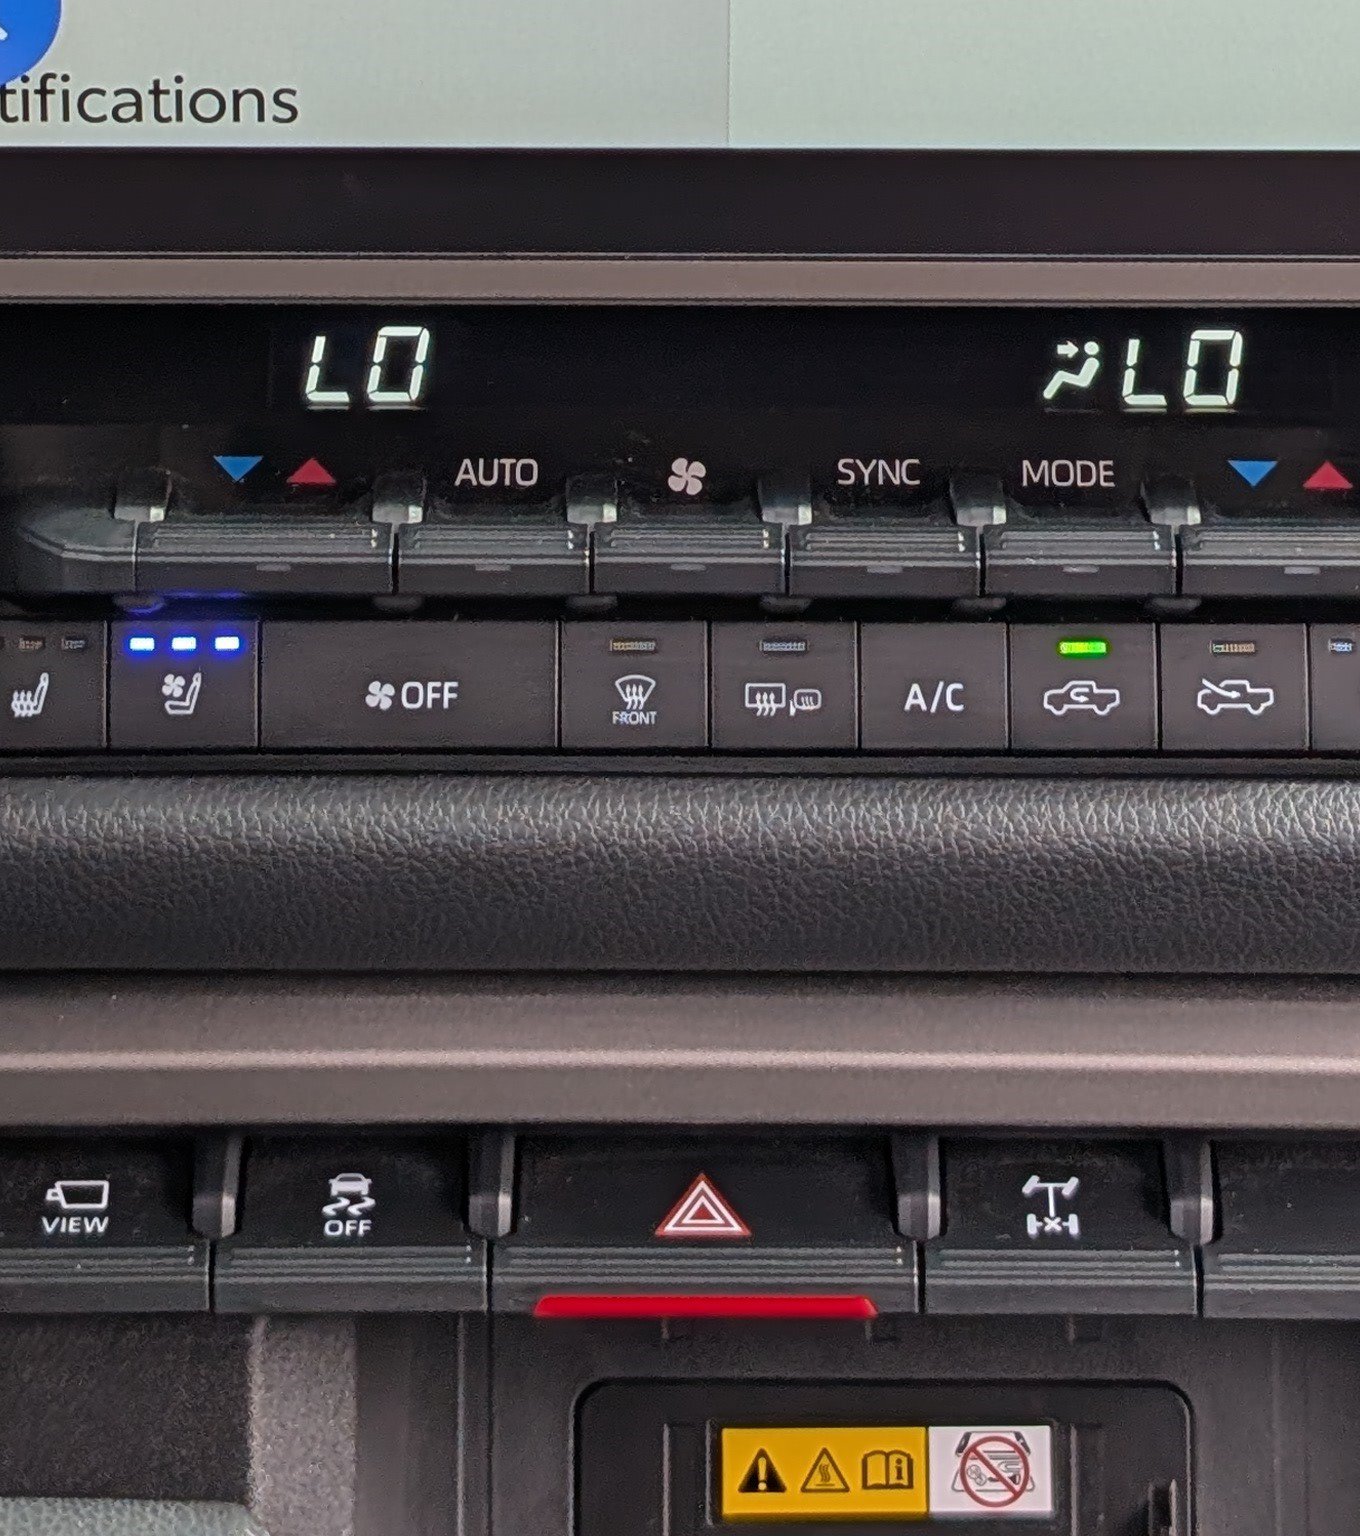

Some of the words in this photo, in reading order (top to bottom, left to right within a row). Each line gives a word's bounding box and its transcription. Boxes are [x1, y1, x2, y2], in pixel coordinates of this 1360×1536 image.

[455, 458, 538, 487] AUTO
[838, 459, 920, 485] SYNC
[1023, 460, 1115, 487] MODE
[401, 682, 458, 709] OFF
[905, 681, 964, 713] A/C
[613, 710, 657, 725] FRONT
[42, 1217, 108, 1233] VIEW
[324, 1220, 371, 1236] OFF
